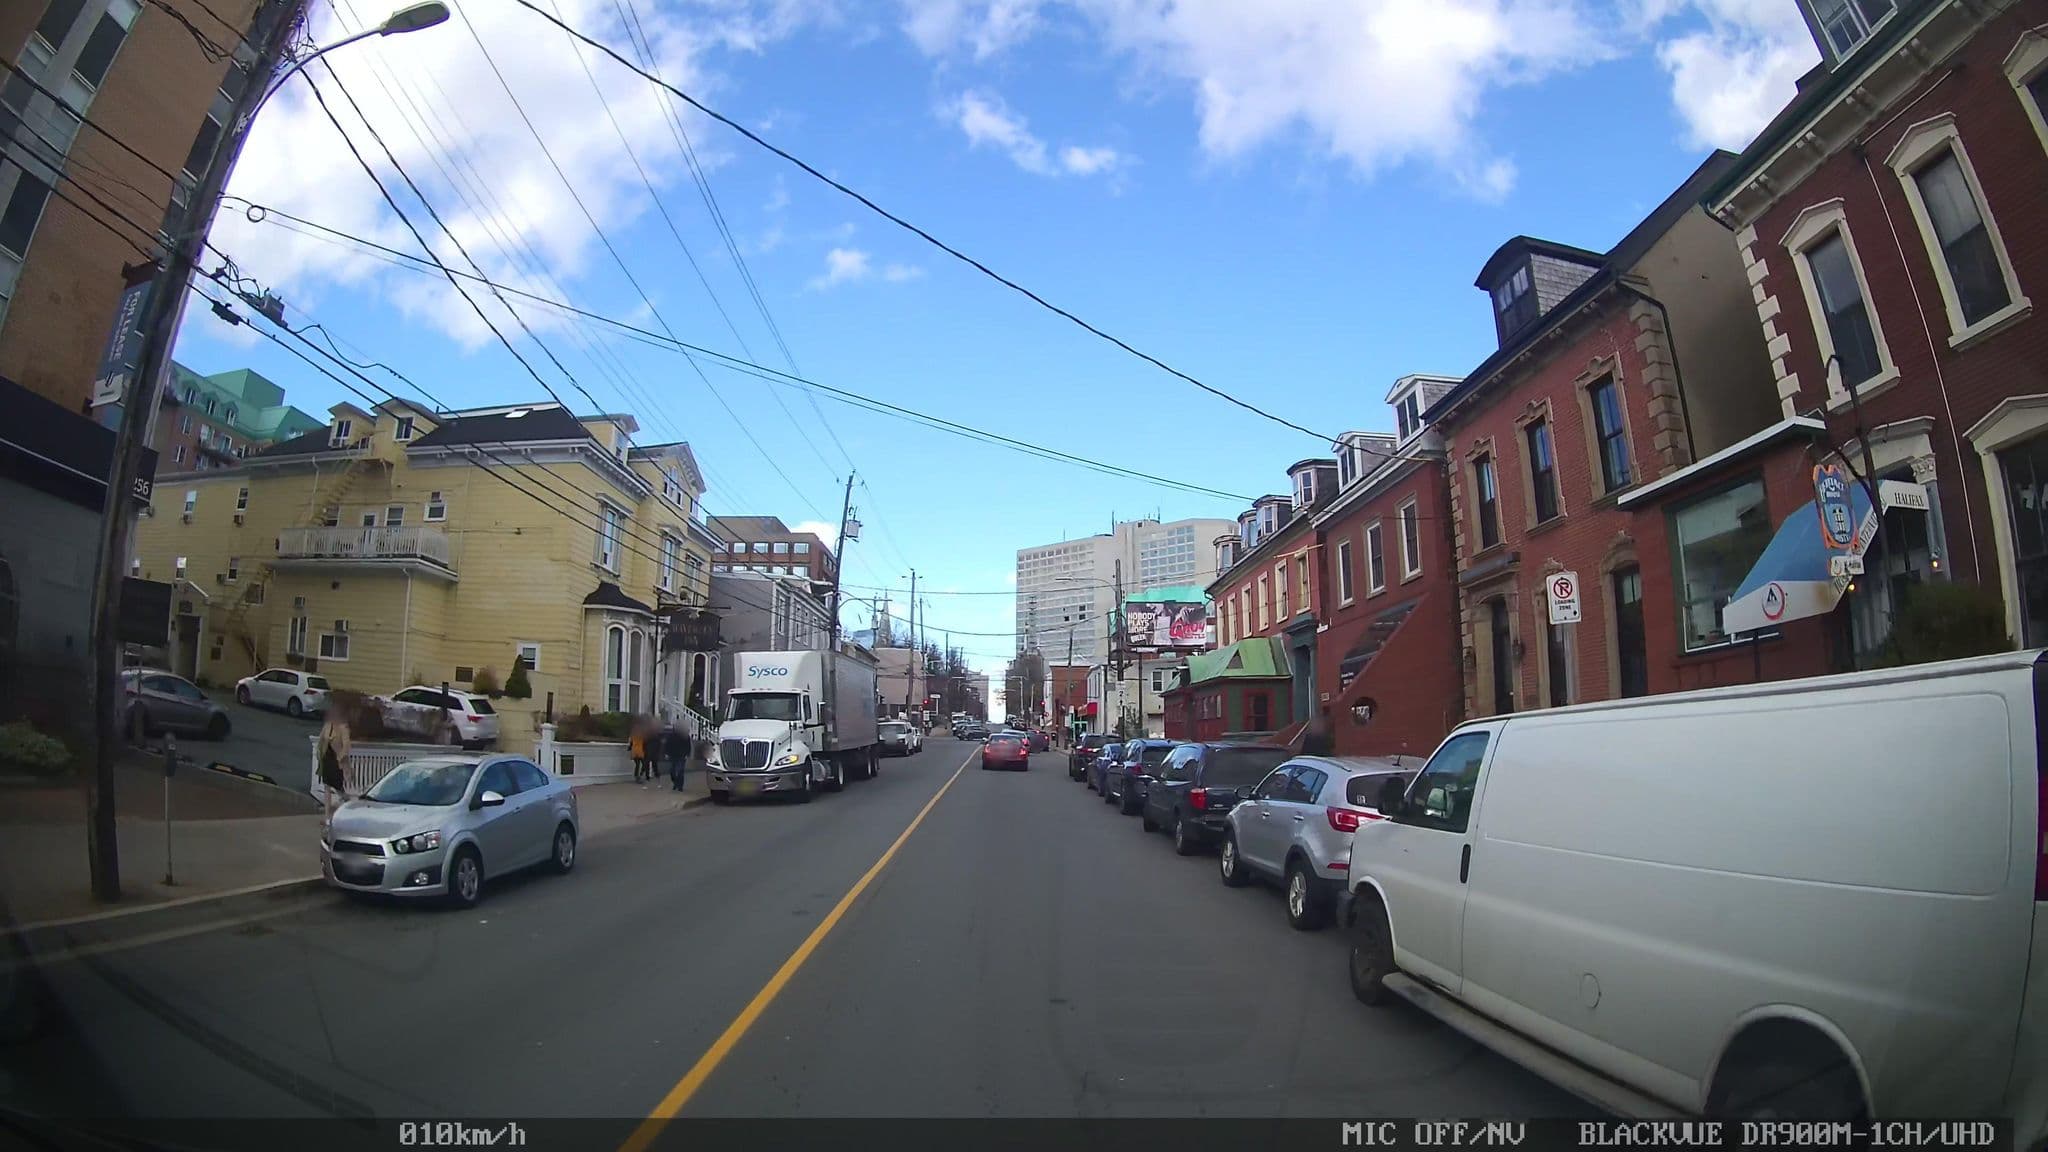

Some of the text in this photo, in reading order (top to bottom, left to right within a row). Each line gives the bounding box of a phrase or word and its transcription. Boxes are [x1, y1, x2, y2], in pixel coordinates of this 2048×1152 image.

[127, 291, 141, 316] FOR
[113, 319, 132, 361] LEASE
[1894, 492, 1925, 507] HALIFAX
[1127, 612, 1156, 620] NOBODY
[1127, 619, 1150, 627] PLAYS
[748, 665, 788, 679] Sysco
